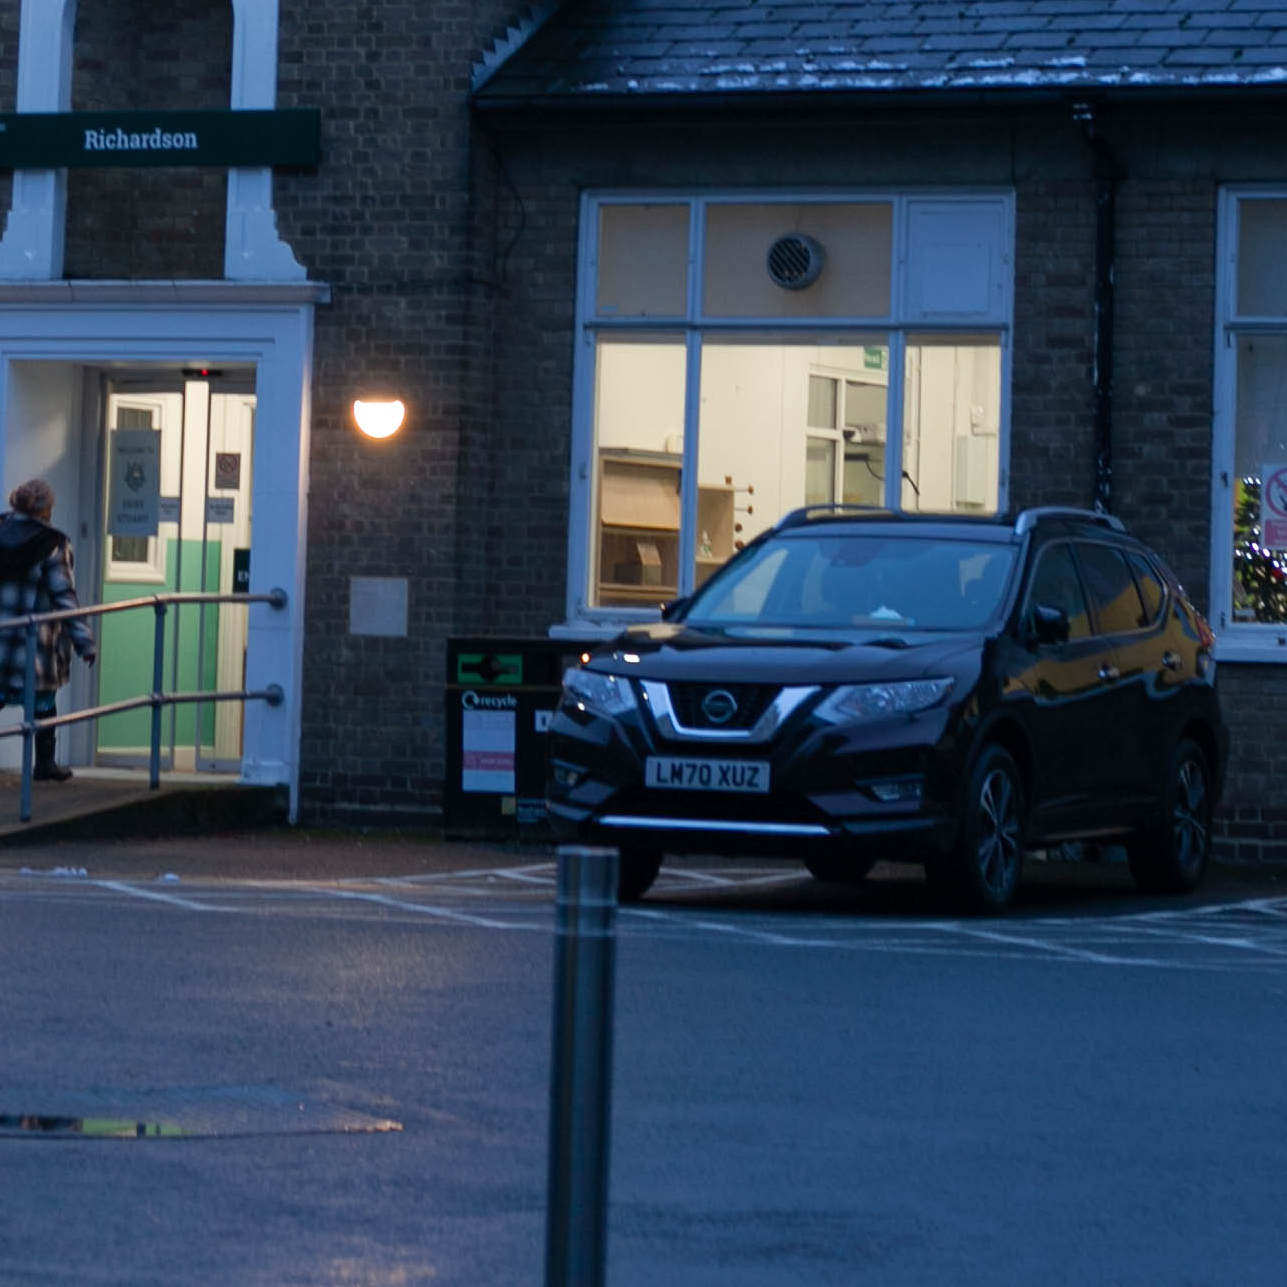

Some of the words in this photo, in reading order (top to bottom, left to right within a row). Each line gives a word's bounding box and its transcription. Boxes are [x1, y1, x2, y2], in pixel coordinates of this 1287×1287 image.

[84, 127, 198, 150] Richardson
[656, 760, 712, 786] LM70
[718, 764, 760, 788] XUZ
